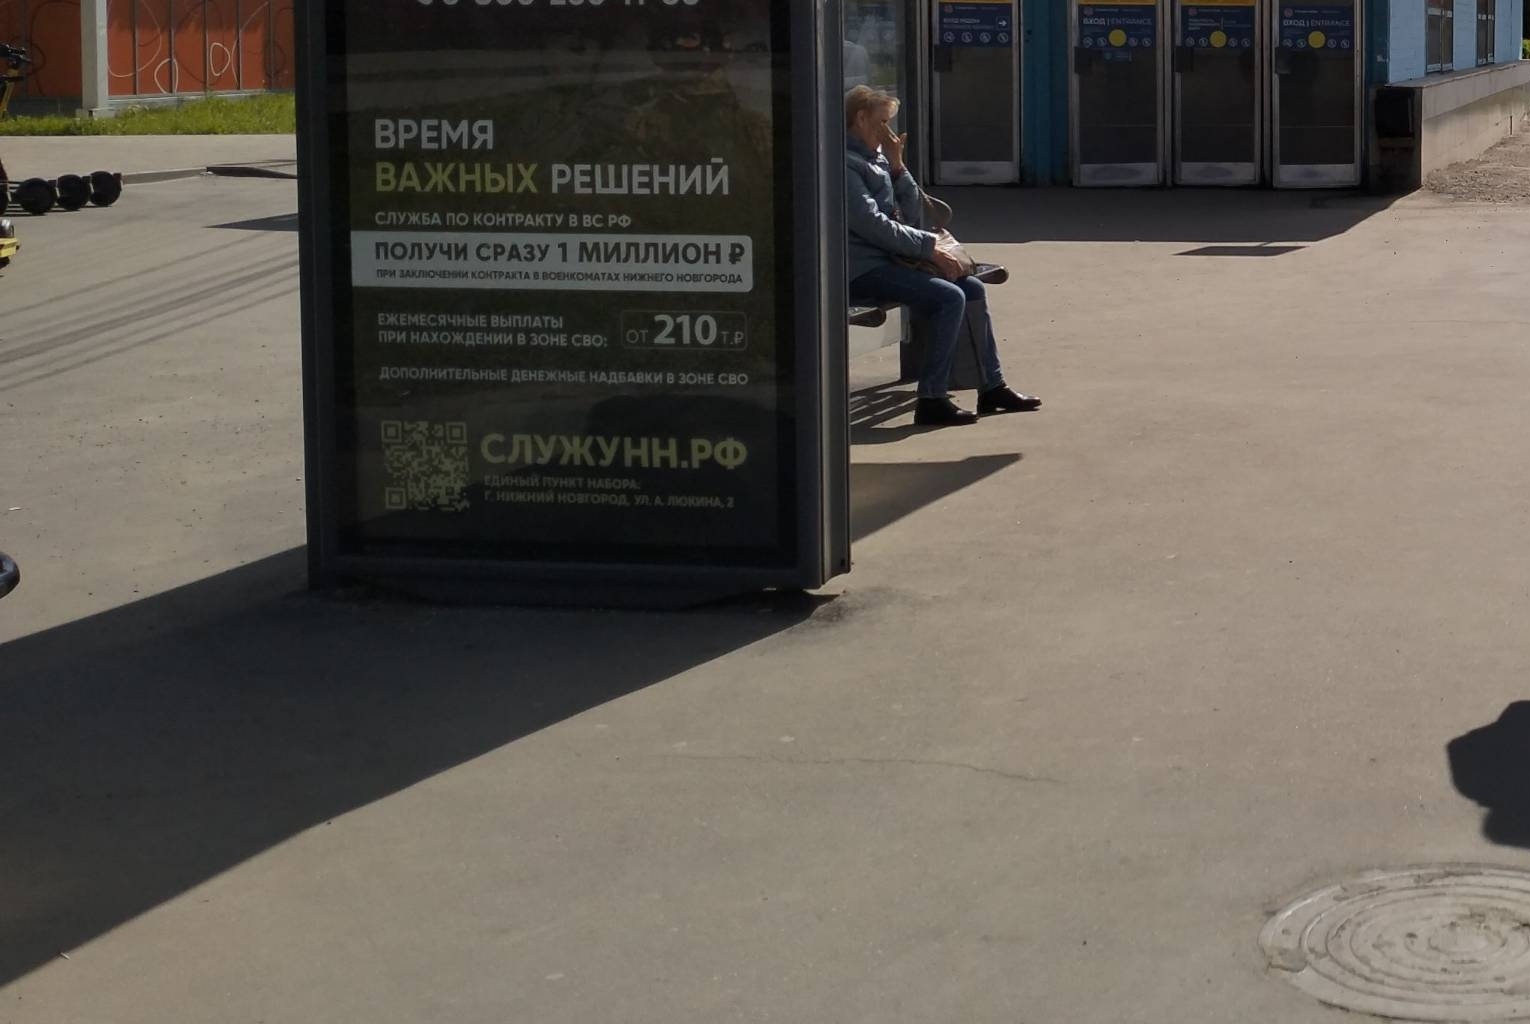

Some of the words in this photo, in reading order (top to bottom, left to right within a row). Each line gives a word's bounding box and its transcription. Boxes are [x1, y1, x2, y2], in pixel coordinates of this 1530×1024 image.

[1083, 17, 1106, 26] ВХОД
[1110, 17, 1153, 26] ENTRANCE
[1283, 19, 1307, 27] ВХОД
[1310, 19, 1352, 27] ENTRANCE
[375, 119, 494, 150] ВРЕМЯ
[375, 162, 539, 194] ВАЖНЫХ
[551, 158, 729, 196] РЕШЕНИЙ
[375, 213, 442, 227] СЛУЖБА
[446, 213, 469, 227] ПО
[473, 213, 564, 228] КОНТРАКТУ
[568, 215, 578, 228] В
[582, 215, 603, 228] ВС
[607, 215, 632, 229] РФ
[375, 242, 469, 262] ПОЛУЧИ
[475, 243, 550, 263] СРАЗУ
[556, 243, 568, 264] 1
[578, 242, 722, 265] МИЛЛИОН
[376, 269, 396, 279] ПРИ
[399, 269, 469, 279] ЗАКЛЮЧЕНИИ
[471, 270, 530, 280] КОНТРАКТА
[542, 271, 620, 282] ВОЕНКОМАТАХ
[623, 272, 674, 283] НИЖНЕГО
[676, 273, 743, 284] НОВГОРОДА
[377, 313, 487, 328] ЕЖЕМЕСЯЧНЫЕ
[490, 314, 563, 329] ВЫПЛАТЫ
[653, 314, 718, 345] 210
[378, 330, 406, 344] ПРИ
[410, 331, 514, 347] НАХОЖДЕНИИ
[517, 333, 526, 345] В
[529, 333, 568, 346] ЗОНЕ
[571, 334, 608, 348] СВО:
[379, 367, 508, 382] ДОПОЛНИТЕЛЬНЫЕ
[511, 369, 586, 384] ДЕНЕЖНЫЕ
[589, 371, 662, 385] НАДБАВКИ
[666, 372, 675, 384] В
[678, 372, 714, 385] ЗОНЕ
[718, 373, 749, 385] СВО
[480, 433, 748, 470] СЛУЖУНН.РФ
[484, 474, 539, 488] ЕДИНЫЙ
[542, 477, 584, 489] ПУНКТ
[496, 490, 554, 504] НИЖНИЙ
